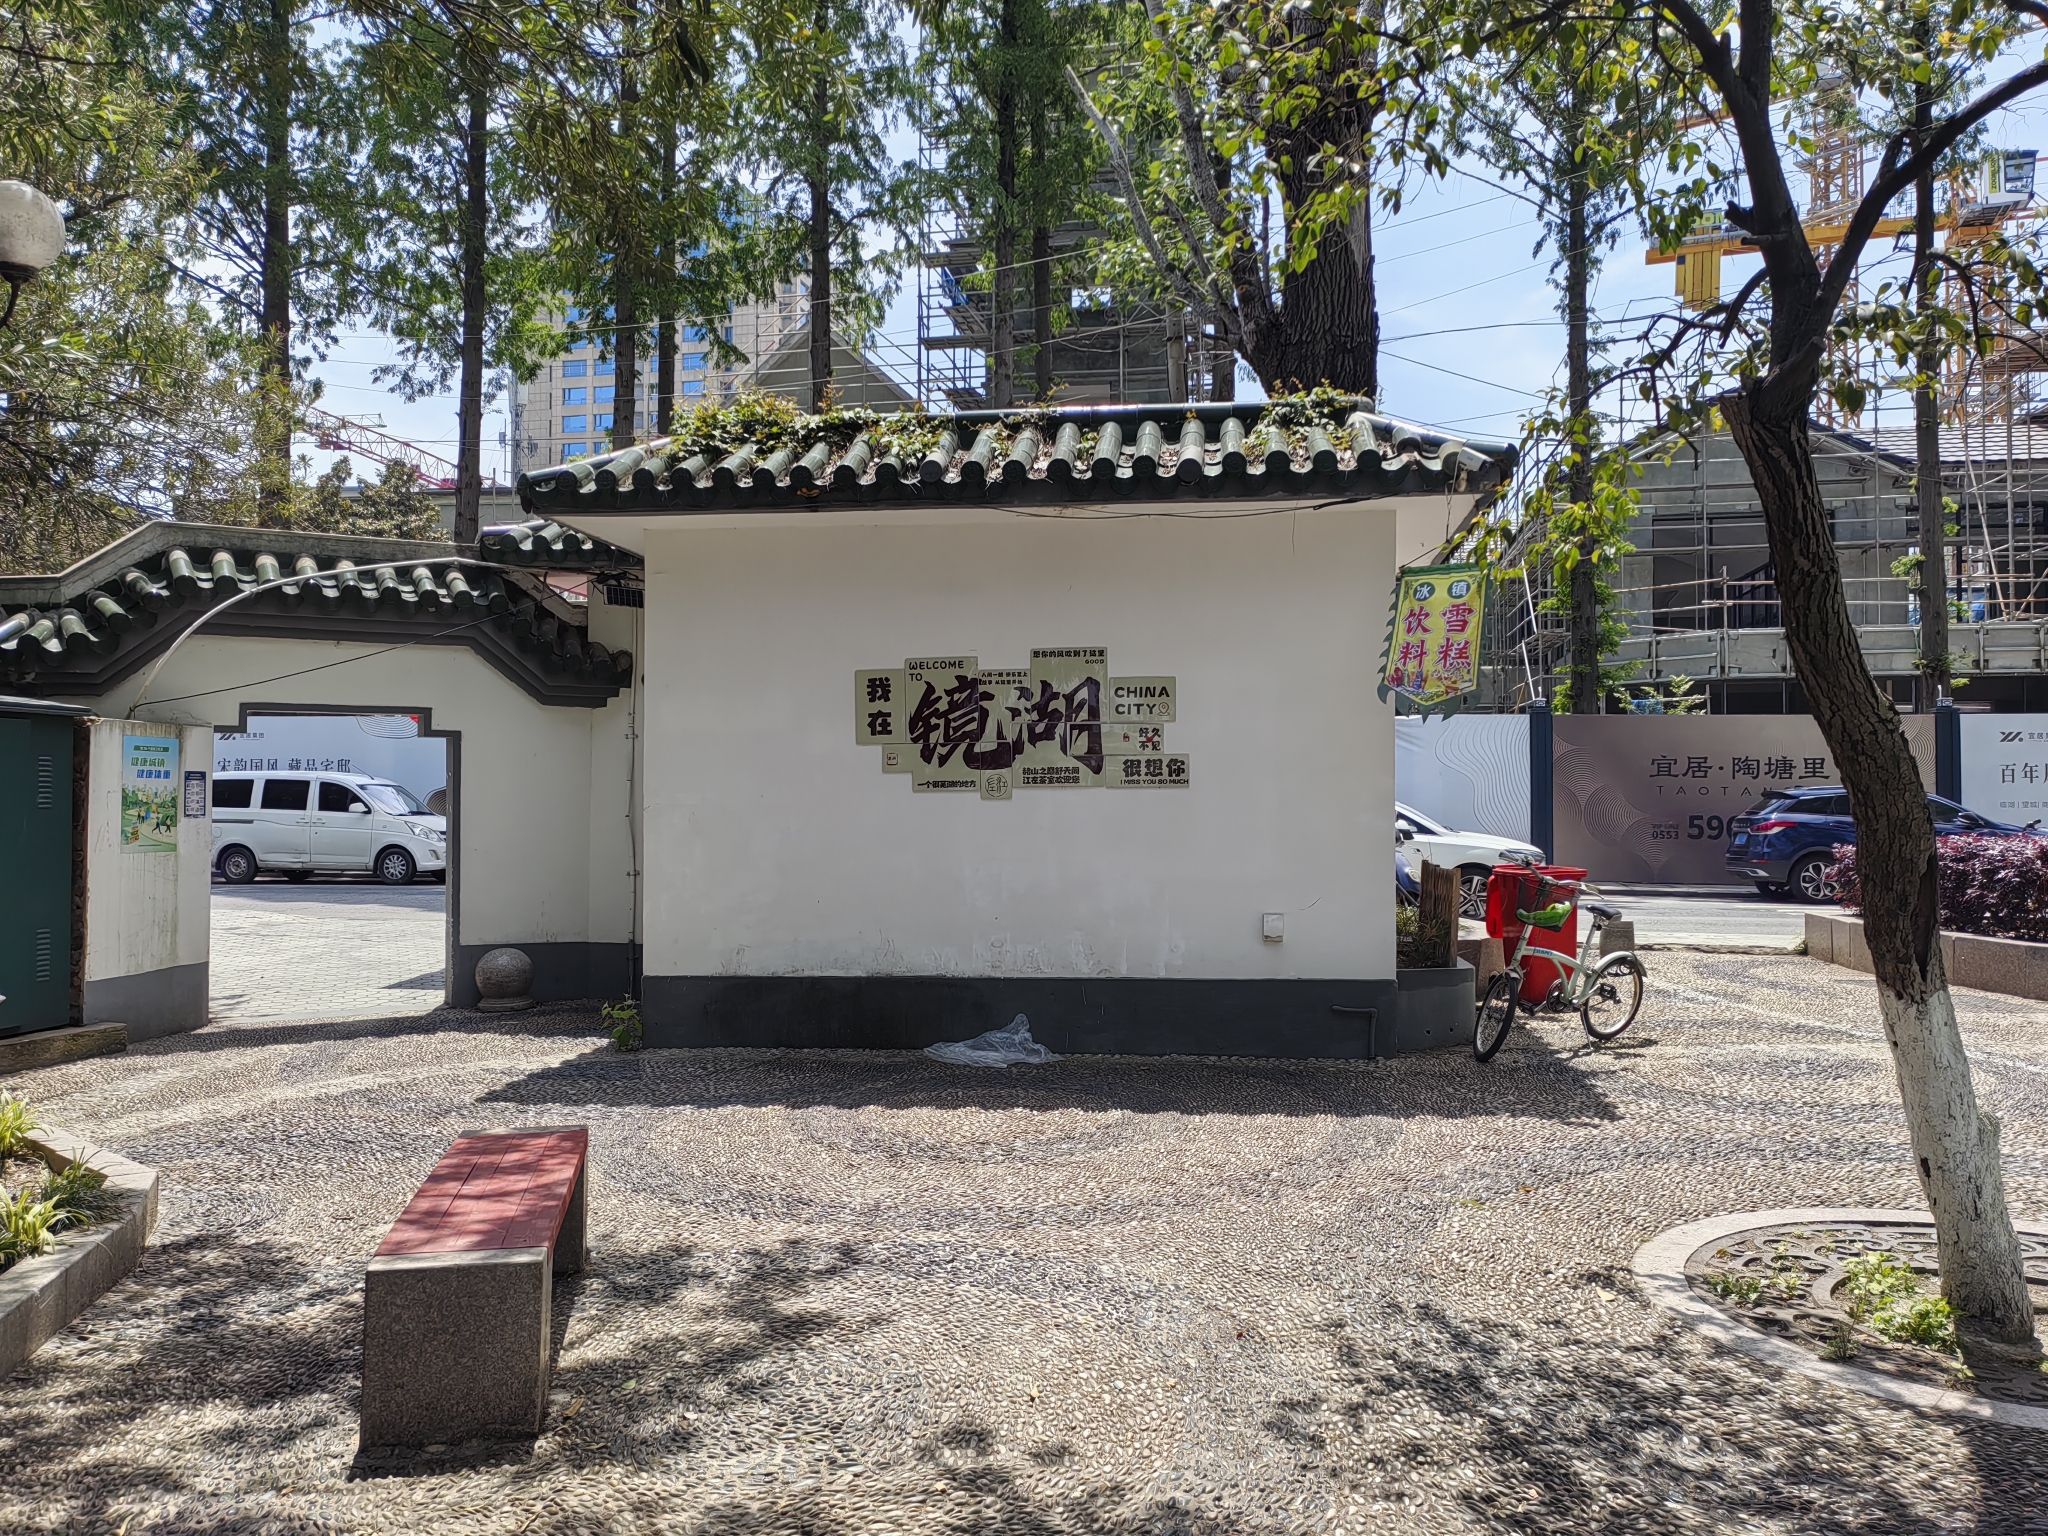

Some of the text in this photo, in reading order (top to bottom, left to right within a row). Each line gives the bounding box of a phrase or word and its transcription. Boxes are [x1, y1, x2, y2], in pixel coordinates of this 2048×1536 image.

[1415, 581, 1468, 600] 冰镇
[1399, 605, 1432, 670] 饮料
[1436, 602, 1475, 670] 雪糕
[1033, 650, 1105, 658] 想你的风吹到了这里
[908, 660, 965, 670] WELCOME
[909, 673, 923, 682] TO
[1114, 686, 1170, 698] CHINA
[867, 677, 892, 736] 我在
[1115, 703, 1156, 715] CITY
[908, 674, 1103, 775] 镜湖
[1139, 727, 1160, 738] 好久
[1139, 740, 1160, 751] 不见
[218, 758, 350, 773] 宋韵国风 藏品宅邸
[1122, 758, 1185, 777] 很想你
[1650, 755, 1830, 780] 宜居·陶塘里
[1652, 831, 1679, 840] 0553
